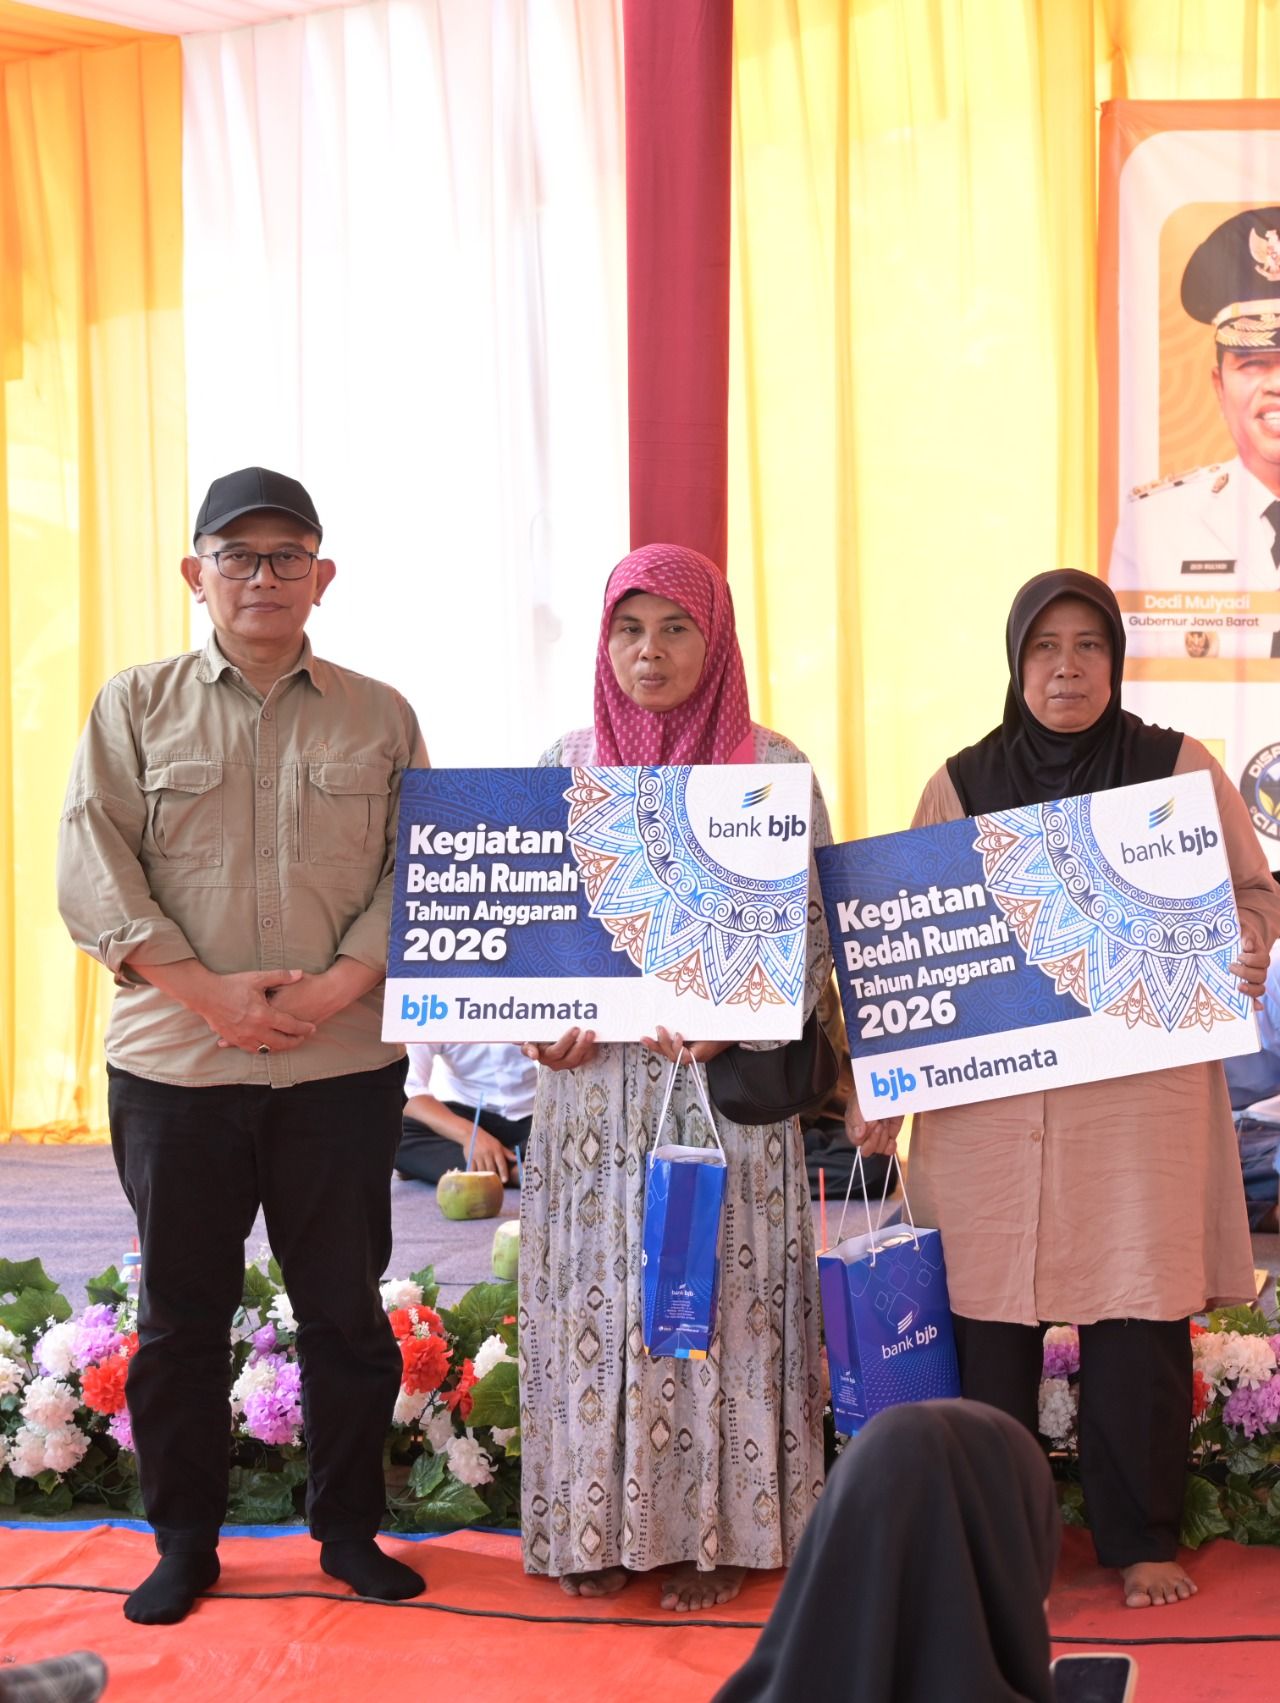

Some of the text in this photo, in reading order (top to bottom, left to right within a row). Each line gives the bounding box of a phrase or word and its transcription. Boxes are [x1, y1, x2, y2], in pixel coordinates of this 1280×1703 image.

[1144, 594, 1250, 613] Dedi Mulyadi
[1128, 616, 1259, 627] Gubernur Jawa Barat
[409, 824, 563, 861] Kegiatan
[709, 815, 807, 842] bank bjb
[1121, 826, 1218, 864] bank bjb
[407, 863, 578, 893] Bedah Rumah
[406, 900, 577, 926] Tahun Anggaran
[837, 882, 987, 933] Kegiatan
[403, 928, 507, 961] 2026
[844, 915, 1010, 971] Bedah Rumah
[850, 954, 1016, 999] Tahun Anggaran
[401, 995, 598, 1026] bjb Tandamata
[857, 990, 957, 1039] 2026
[870, 1046, 1058, 1102] bjb Tandamata
[882, 1325, 938, 1360] bank bjb
